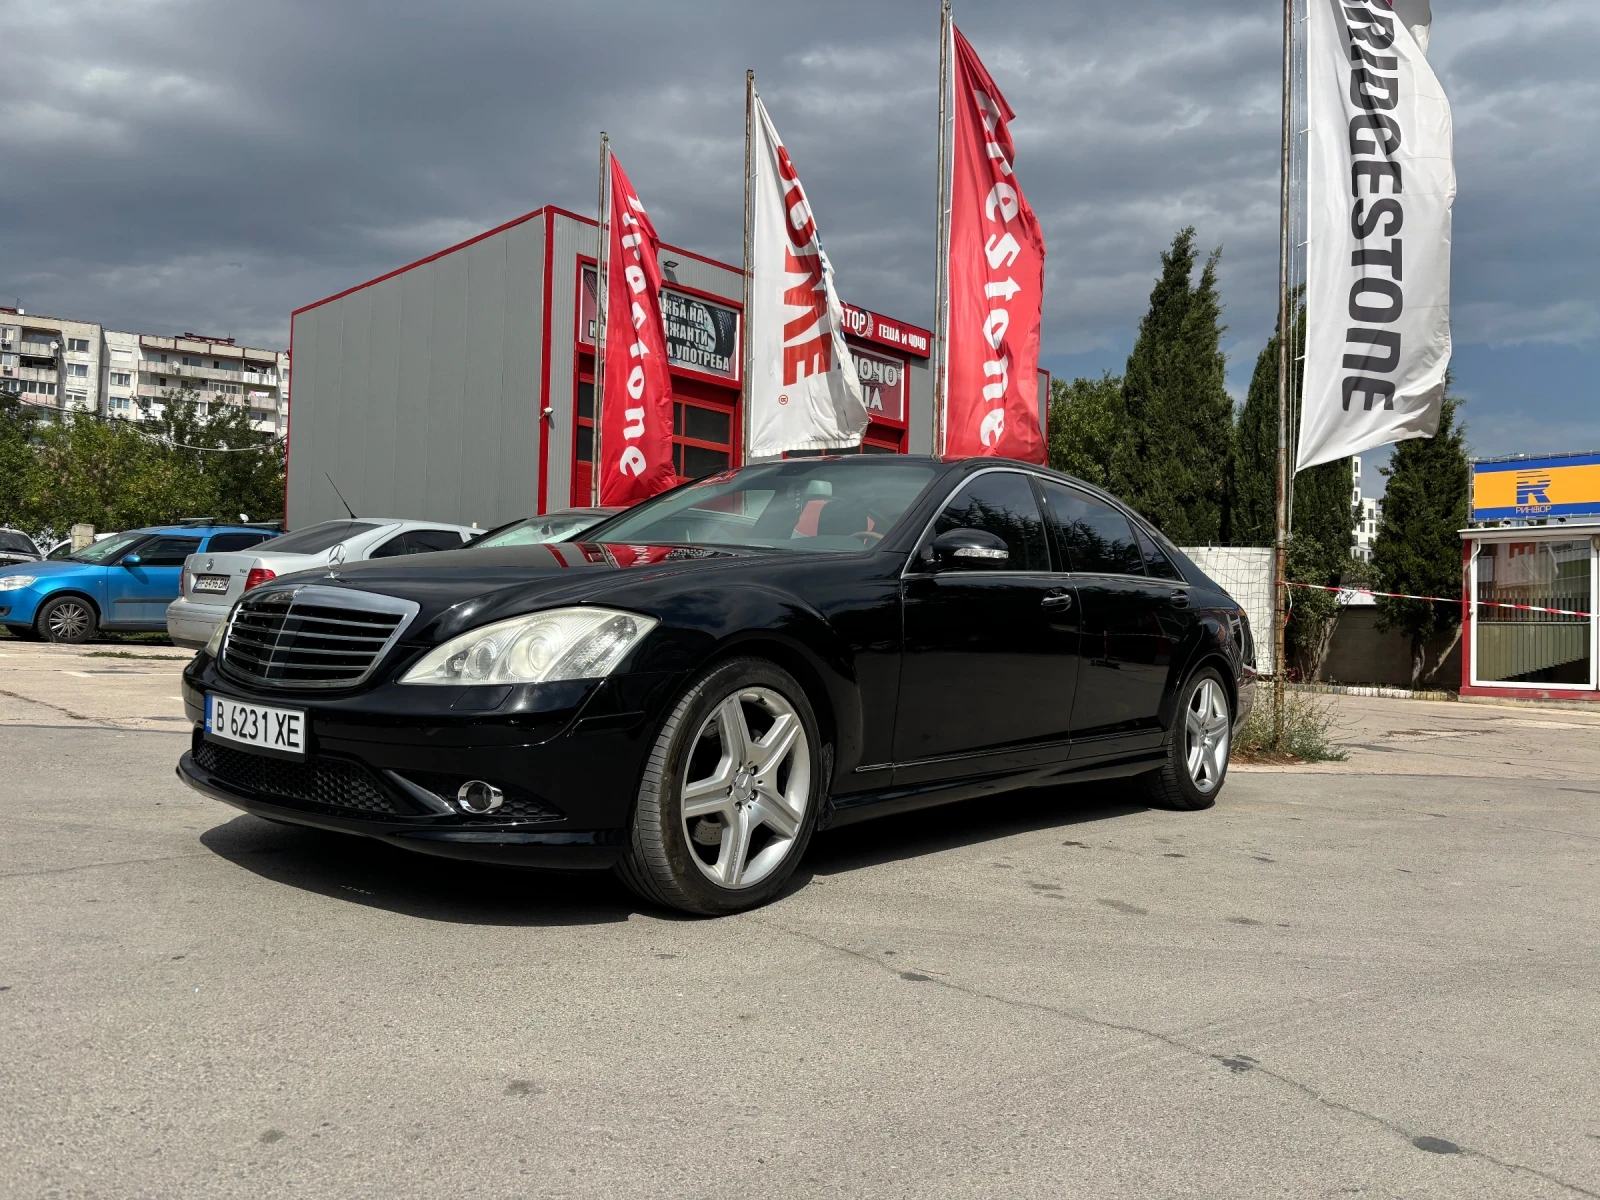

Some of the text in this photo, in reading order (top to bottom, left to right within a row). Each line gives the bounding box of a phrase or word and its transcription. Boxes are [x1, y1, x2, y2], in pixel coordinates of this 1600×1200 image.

[1341, 0, 1404, 412] RIDGESTONE
[689, 306, 705, 324] НА
[878, 323, 901, 343] ГЕША
[908, 333, 927, 351] ЧОЧО
[675, 343, 730, 372] УПОТРЕБА
[216, 700, 300, 748] B 6231 XE
